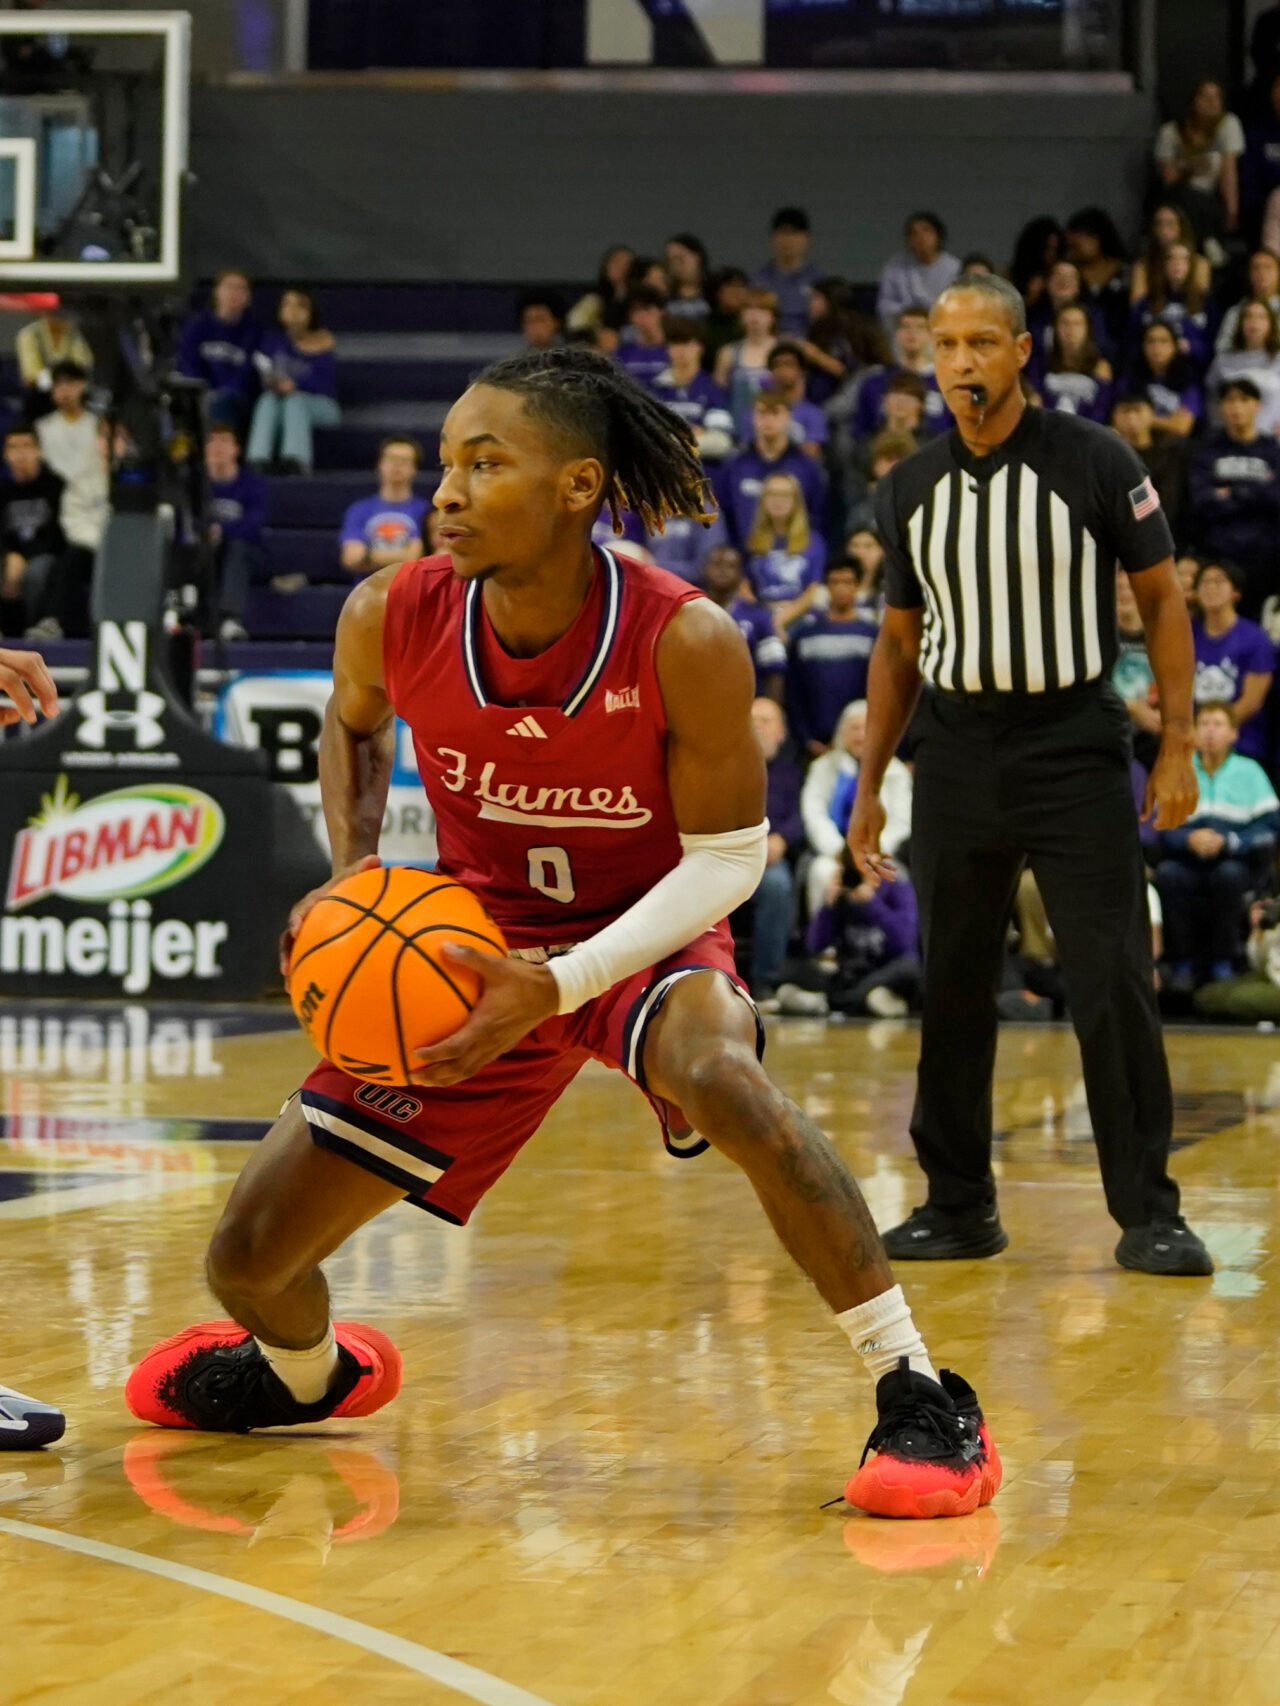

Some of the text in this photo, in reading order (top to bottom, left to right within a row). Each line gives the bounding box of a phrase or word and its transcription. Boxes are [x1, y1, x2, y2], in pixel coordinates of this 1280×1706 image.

[98, 620, 147, 693] N
[437, 747, 649, 815] Flames
[10, 806, 204, 901] LIBMAN
[527, 846, 575, 904] 0
[0, 899, 228, 994] meijer
[356, 1082, 423, 1123] UIC
